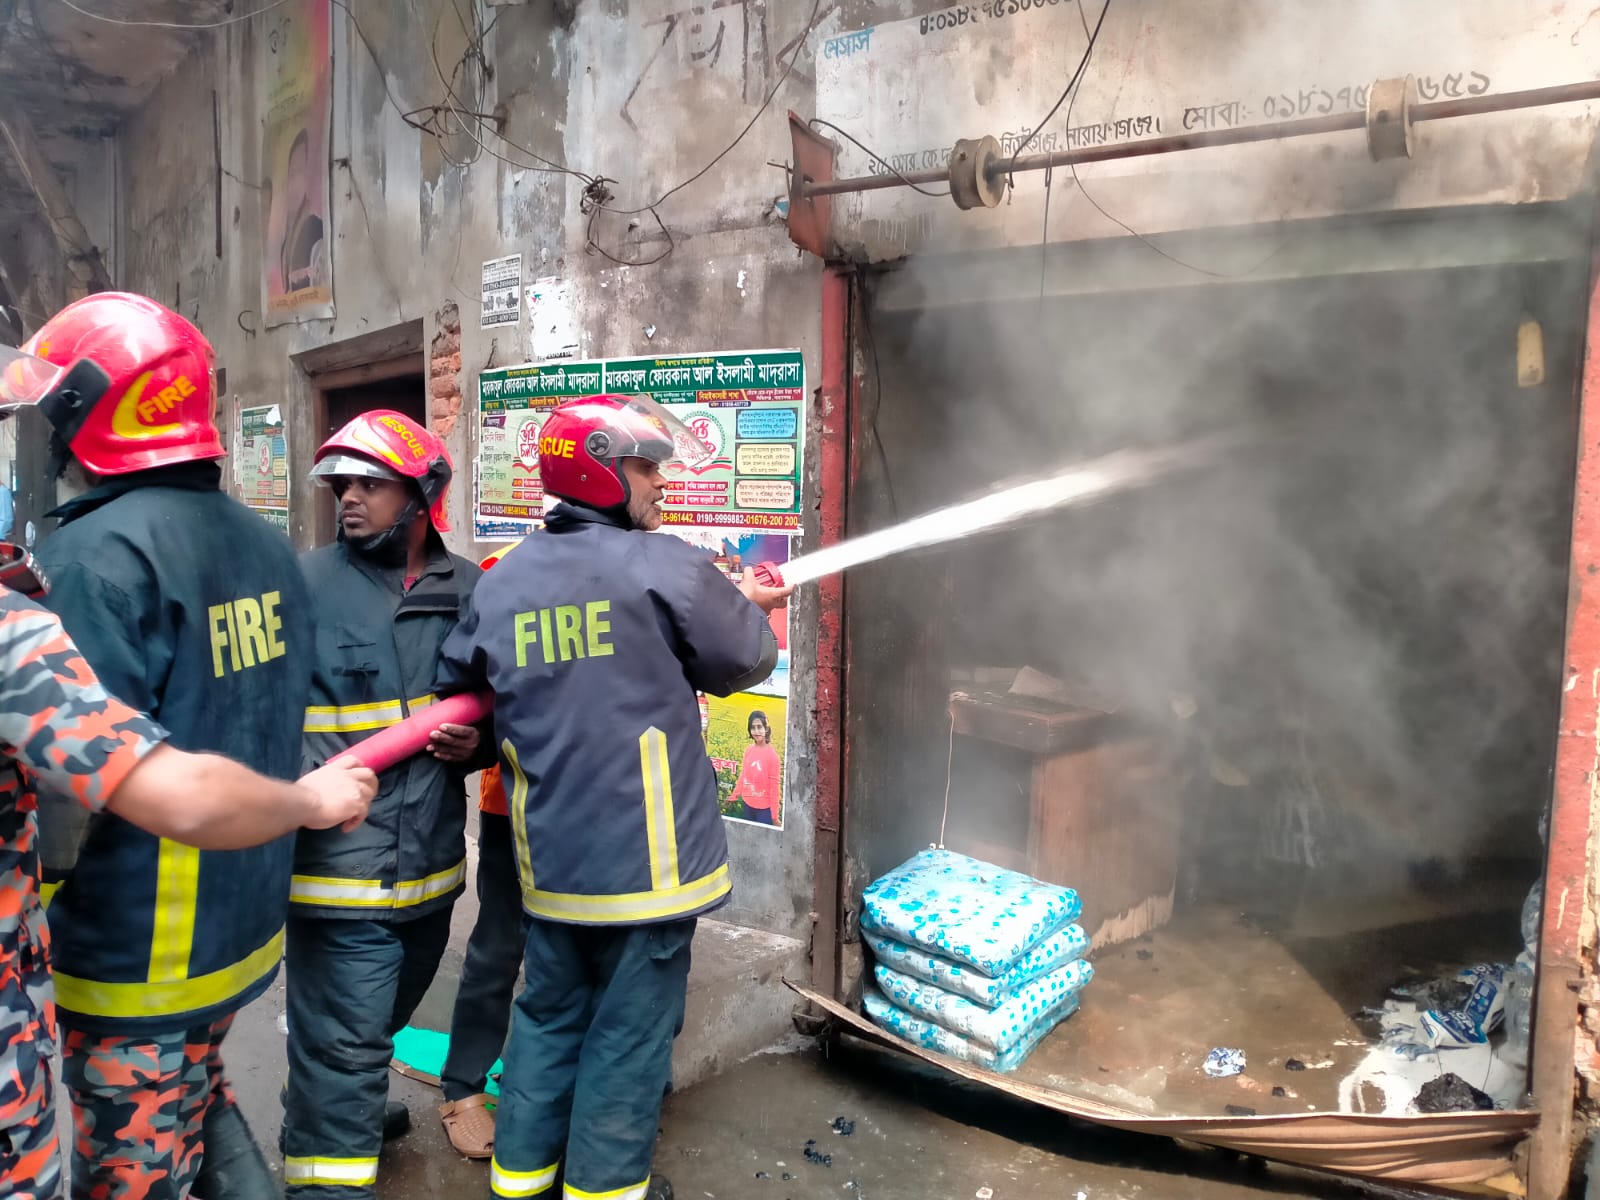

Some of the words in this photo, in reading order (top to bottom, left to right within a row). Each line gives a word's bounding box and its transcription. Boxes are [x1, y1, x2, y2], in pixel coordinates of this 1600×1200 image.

[649, 365, 691, 387] ফোরকান
[692, 364, 713, 385] আল
[716, 357, 755, 385] ইসলামী
[137, 375, 197, 422] FIRE
[376, 416, 426, 459] RESCUE
[539, 435, 577, 459] SCUE
[784, 515, 798, 527] 200
[208, 590, 286, 678] FIRE
[514, 600, 615, 667] FIRE
